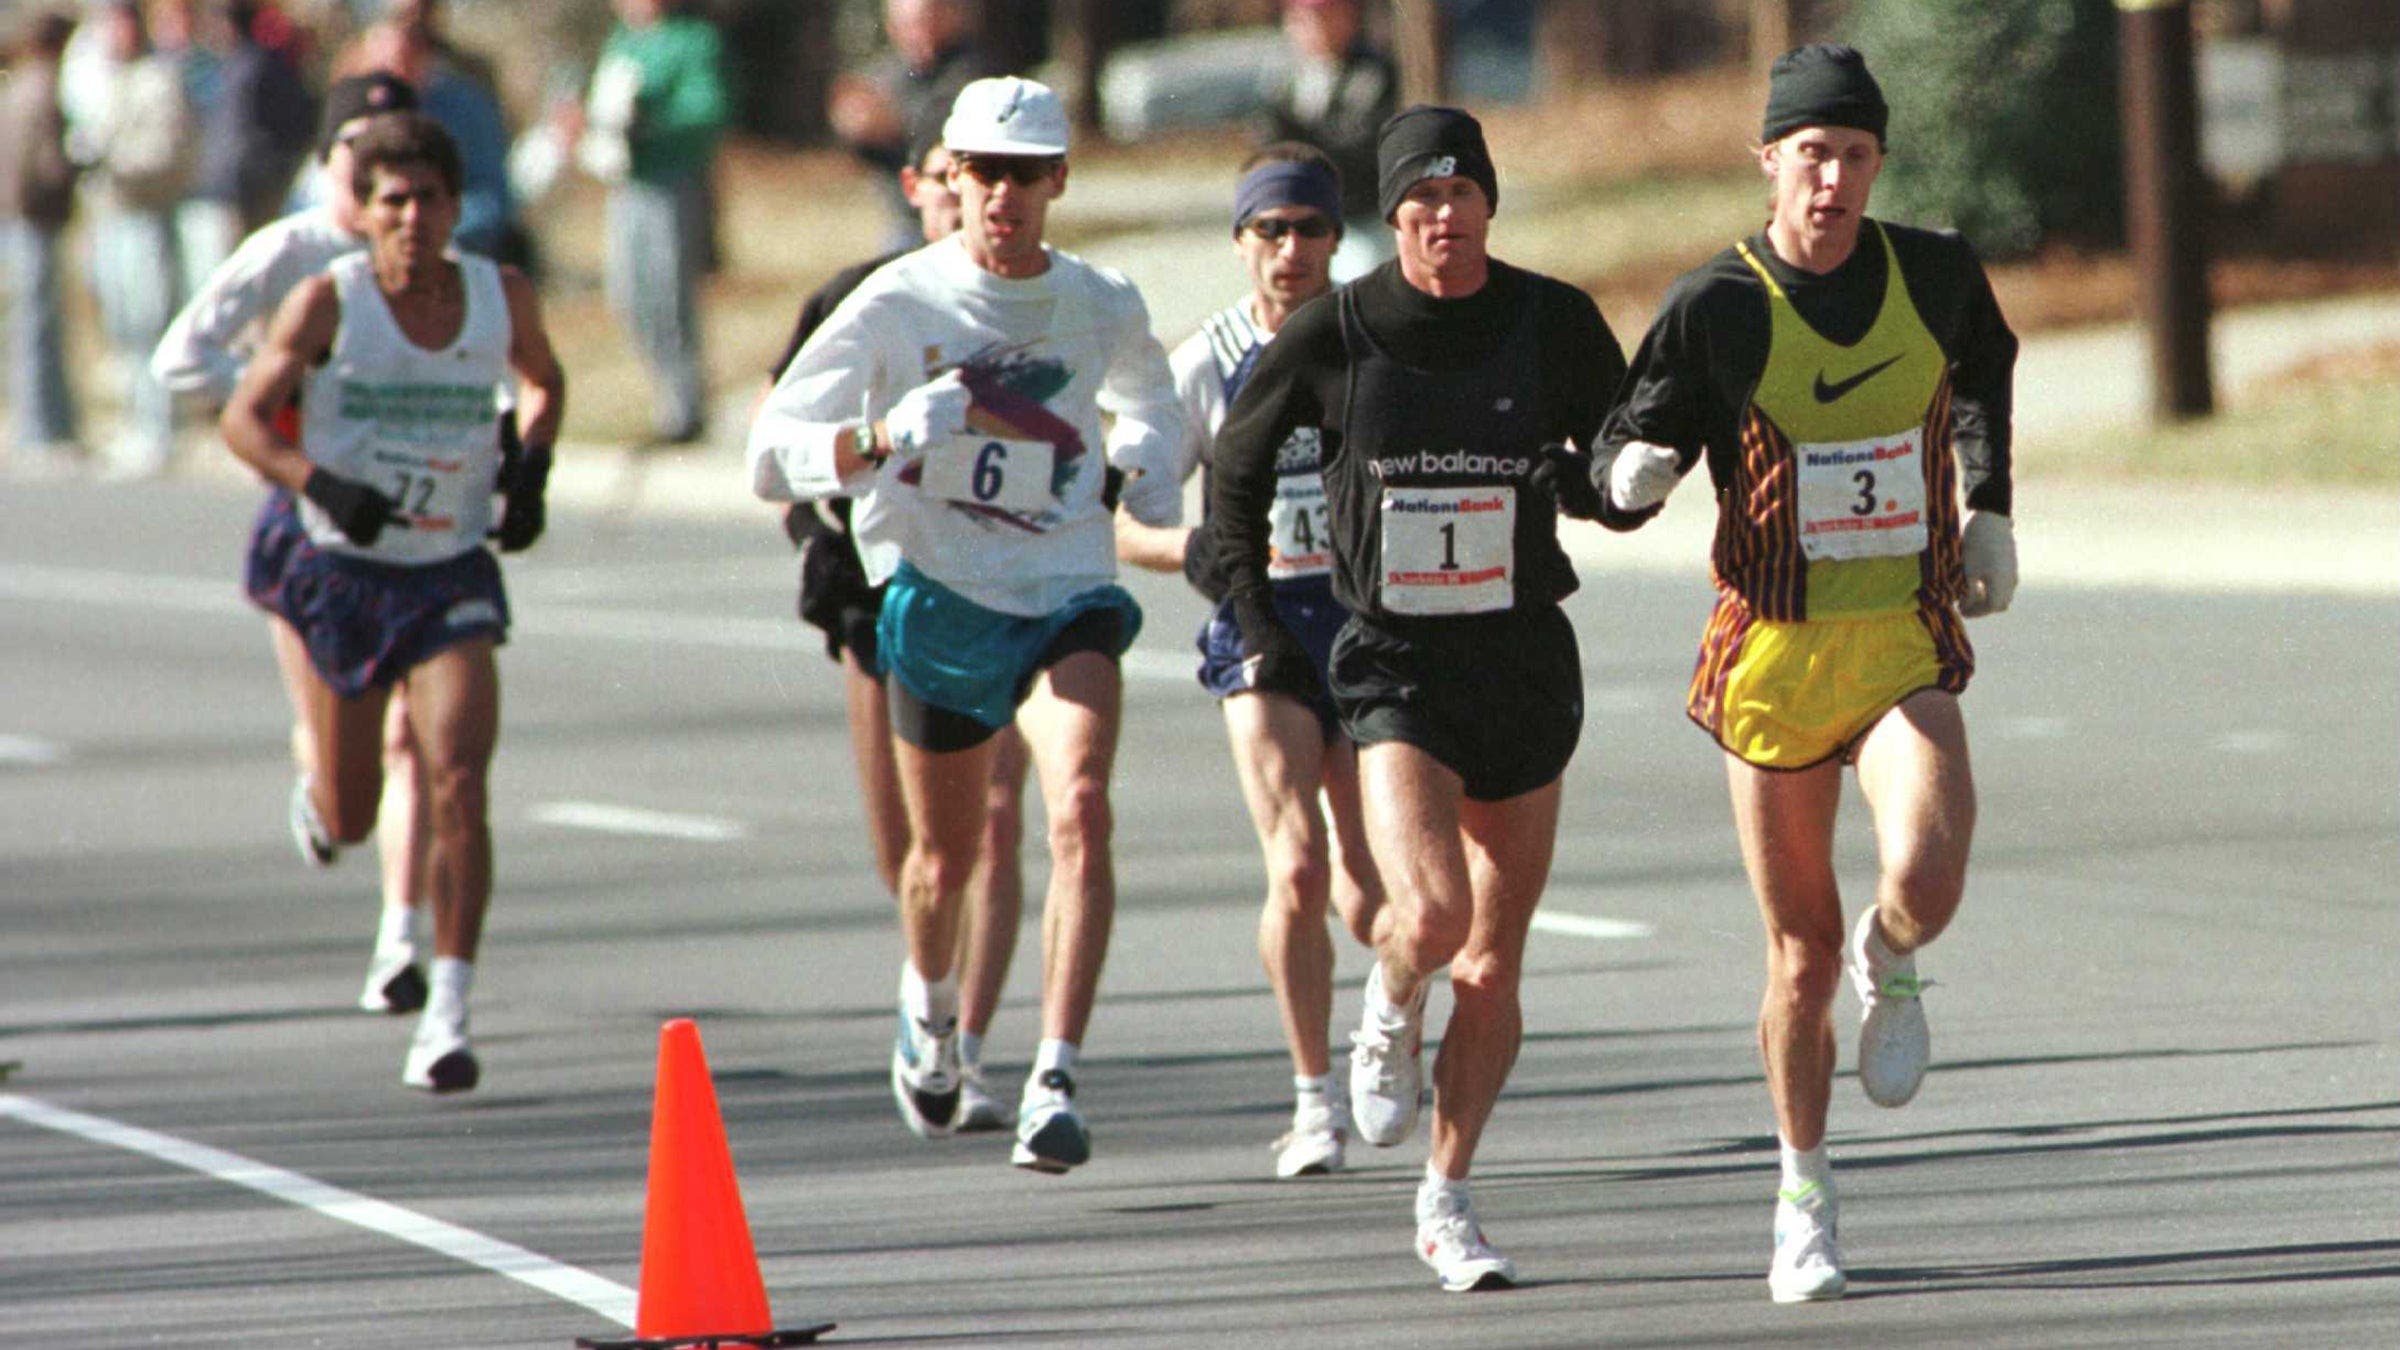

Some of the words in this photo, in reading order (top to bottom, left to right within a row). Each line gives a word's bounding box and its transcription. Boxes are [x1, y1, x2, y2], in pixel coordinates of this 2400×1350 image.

[1422, 156, 1456, 177] NB
[1368, 454, 1416, 479] new
[1421, 449, 1530, 476] balance
[1807, 441, 1913, 466] NationsBank
[972, 441, 1007, 501] 6
[1391, 497, 1504, 513] NationsBank
[1850, 469, 1877, 515] 3
[1439, 521, 1459, 570] 1
